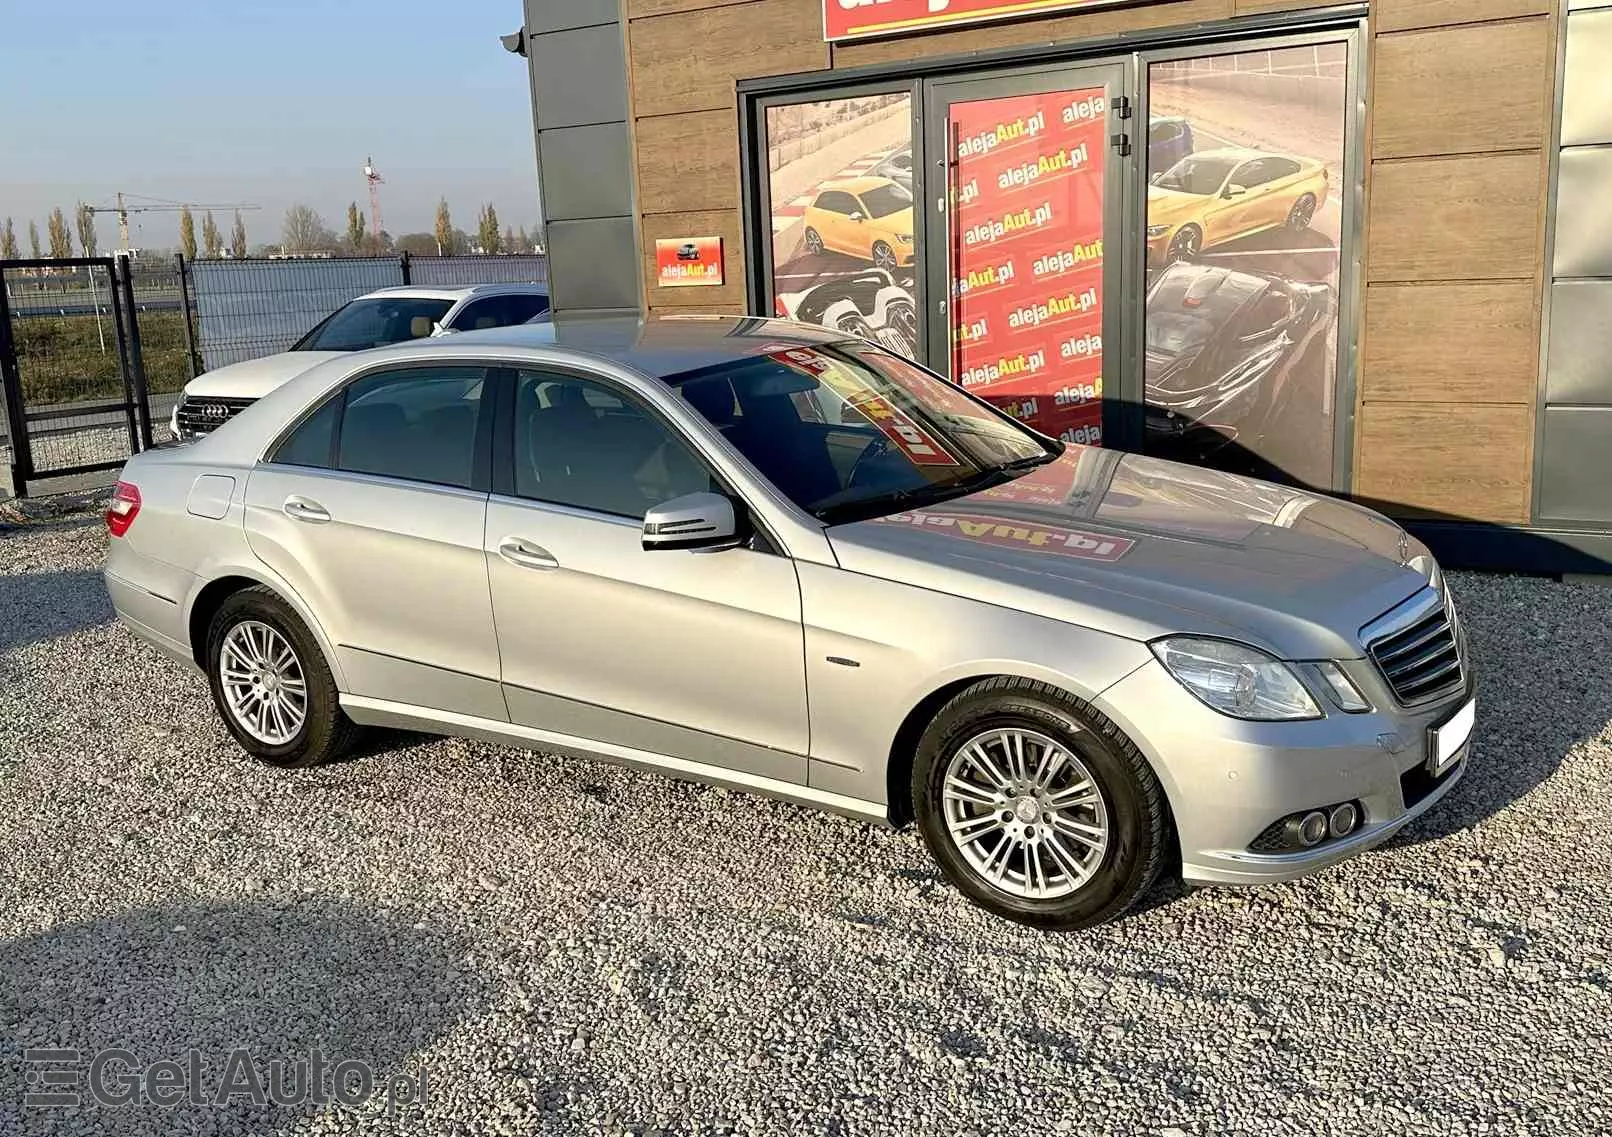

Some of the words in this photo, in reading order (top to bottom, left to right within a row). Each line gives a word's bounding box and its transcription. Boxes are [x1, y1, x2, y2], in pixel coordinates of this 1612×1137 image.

[1062, 95, 1104, 123] aleja
[958, 111, 1045, 157] alejaAut.pl
[998, 143, 1088, 188] alejaAut.pl
[966, 202, 1052, 244] alejaAut.pl
[662, 261, 718, 280] alejaAut.pl
[1033, 240, 1104, 276] alejaAut
[1008, 288, 1097, 328] alejaAut.pl
[1060, 333, 1101, 357] aleja
[961, 350, 1045, 387] alejaAut.pl
